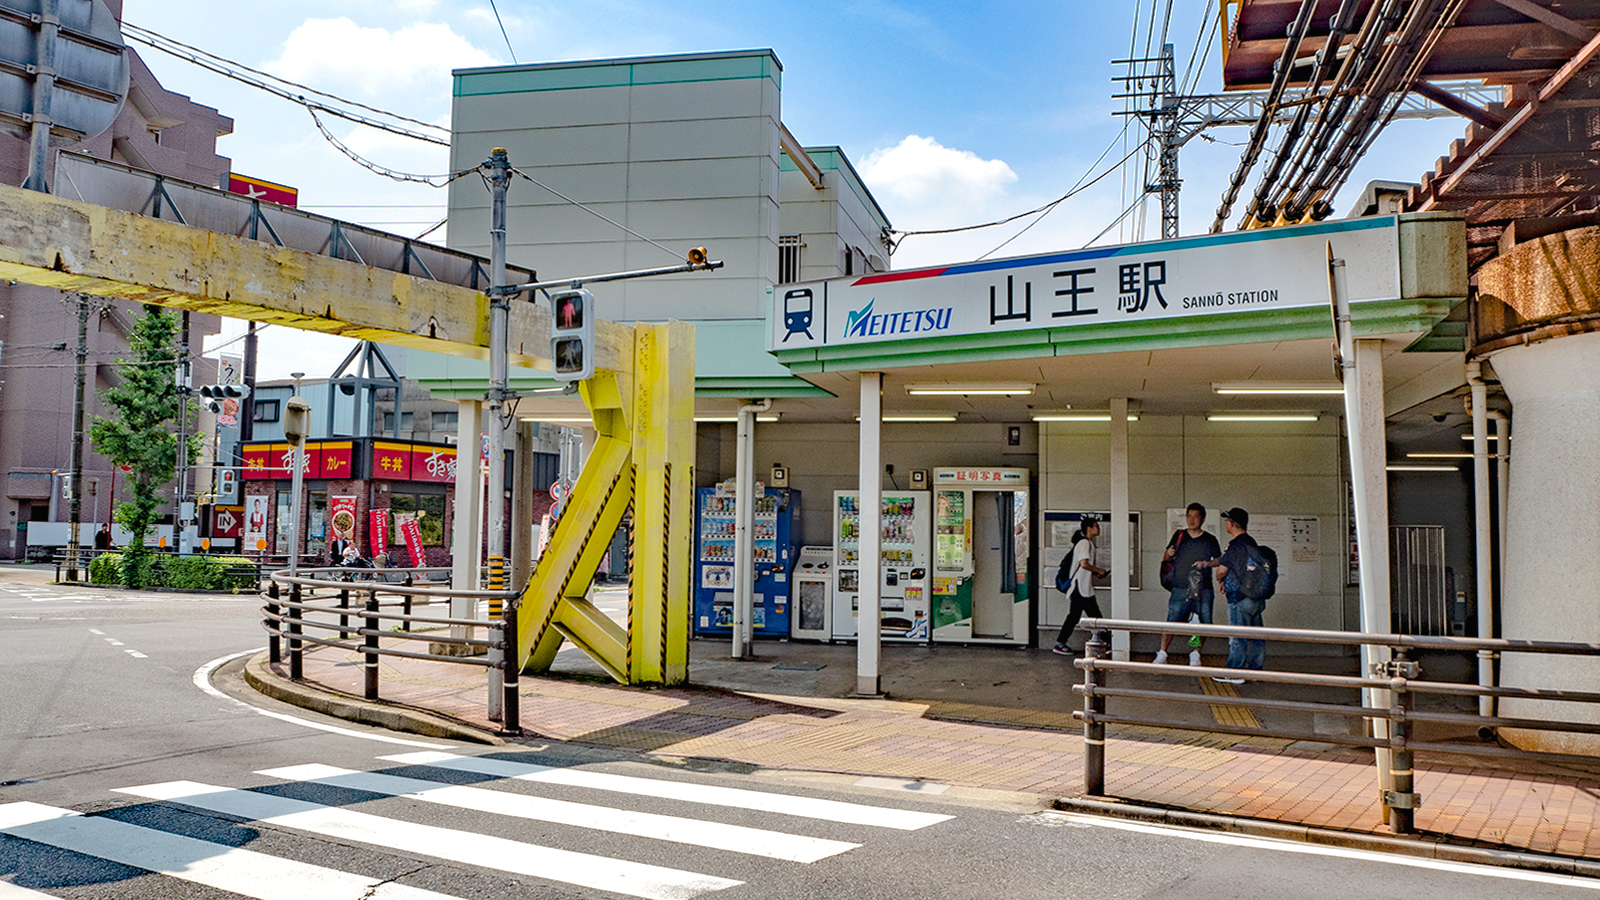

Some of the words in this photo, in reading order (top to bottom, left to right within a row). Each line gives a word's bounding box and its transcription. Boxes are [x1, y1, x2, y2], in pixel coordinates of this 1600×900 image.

[990, 260, 1168, 325] 山王駅
[1182, 291, 1224, 309] SANNŌ
[1227, 289, 1279, 305] STATION
[843, 296, 953, 338] MEITETSU
[326, 456, 347, 471] カレー
[381, 456, 403, 472] 牛丼
[956, 470, 1002, 481] 証明写真
[219, 516, 231, 526] IN
